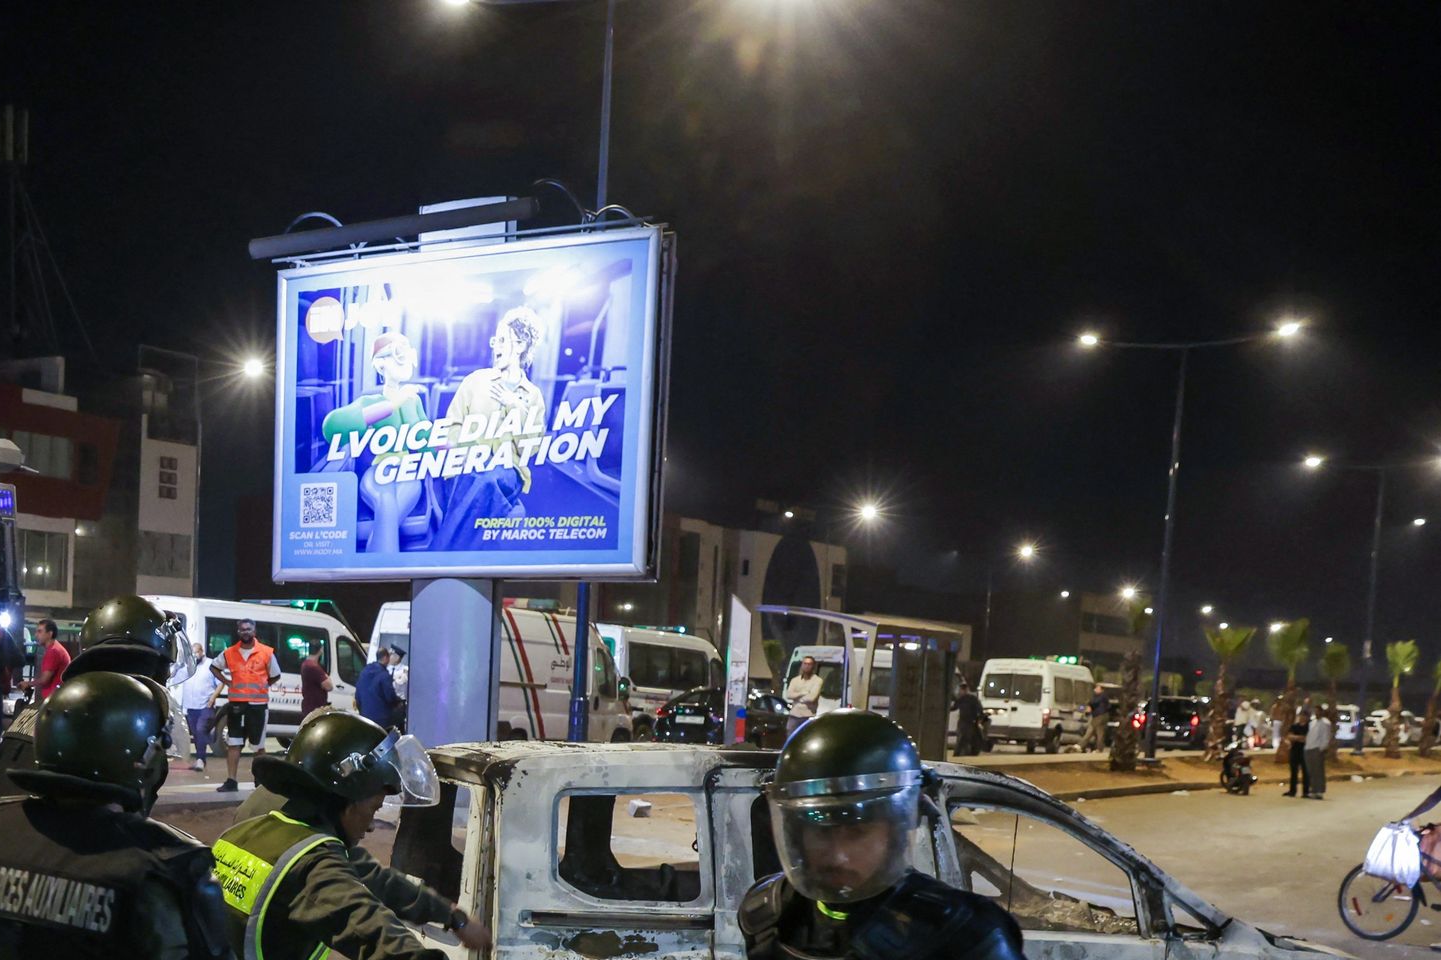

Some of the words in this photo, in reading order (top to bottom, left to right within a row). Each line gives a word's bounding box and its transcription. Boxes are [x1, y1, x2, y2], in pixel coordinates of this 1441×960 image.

[460, 405, 544, 442] DIAL
[553, 394, 618, 431] MY
[373, 428, 610, 485] GENERATION
[289, 531, 314, 540] SCAN
[474, 518, 522, 529] FORFAIT
[524, 517, 555, 528] 100%
[557, 516, 606, 527] DIGITAL
[483, 529, 501, 540] BY
[501, 529, 546, 540] MAROC
[549, 528, 607, 540] TELECOM
[21, 873, 116, 934] AUXILIAIRES
